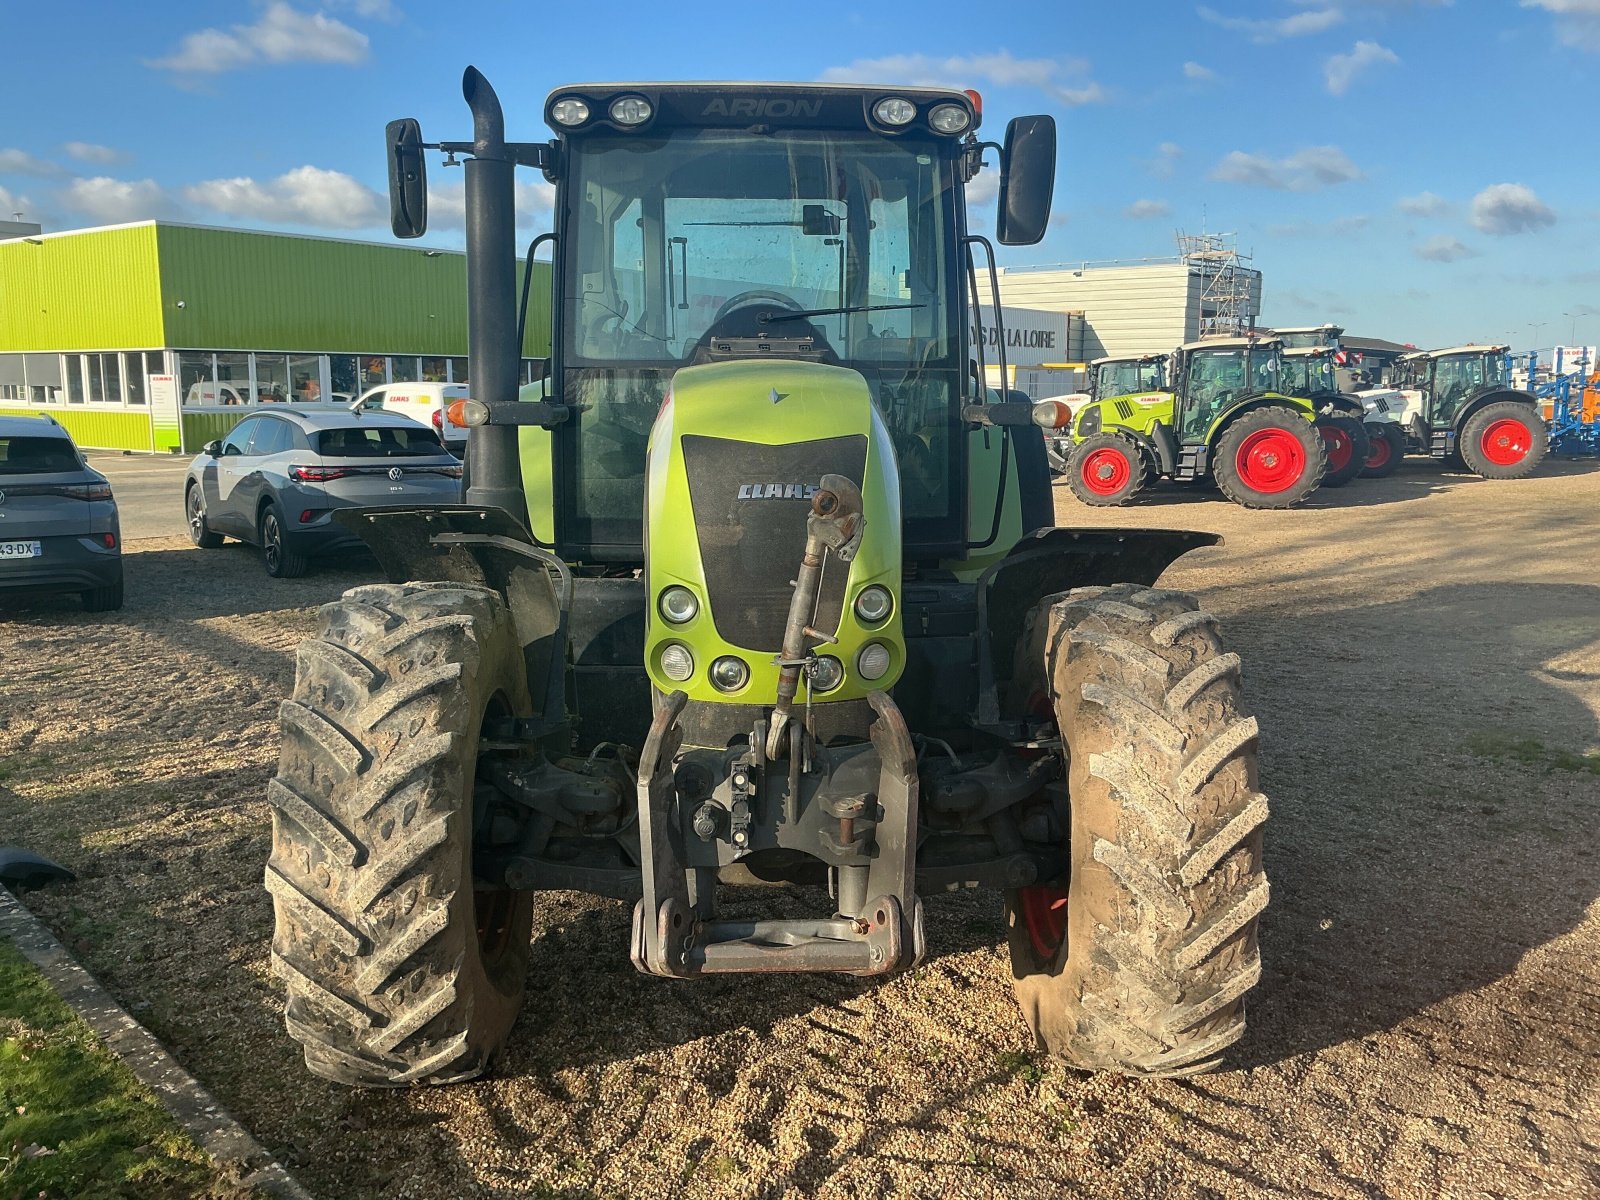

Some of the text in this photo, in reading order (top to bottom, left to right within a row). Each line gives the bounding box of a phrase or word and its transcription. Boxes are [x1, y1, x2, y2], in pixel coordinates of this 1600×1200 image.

[701, 98, 824, 117] ARION
[1007, 328, 1022, 347] LA
[1024, 329, 1055, 348] LOIRE
[737, 483, 820, 500] CLAAS
